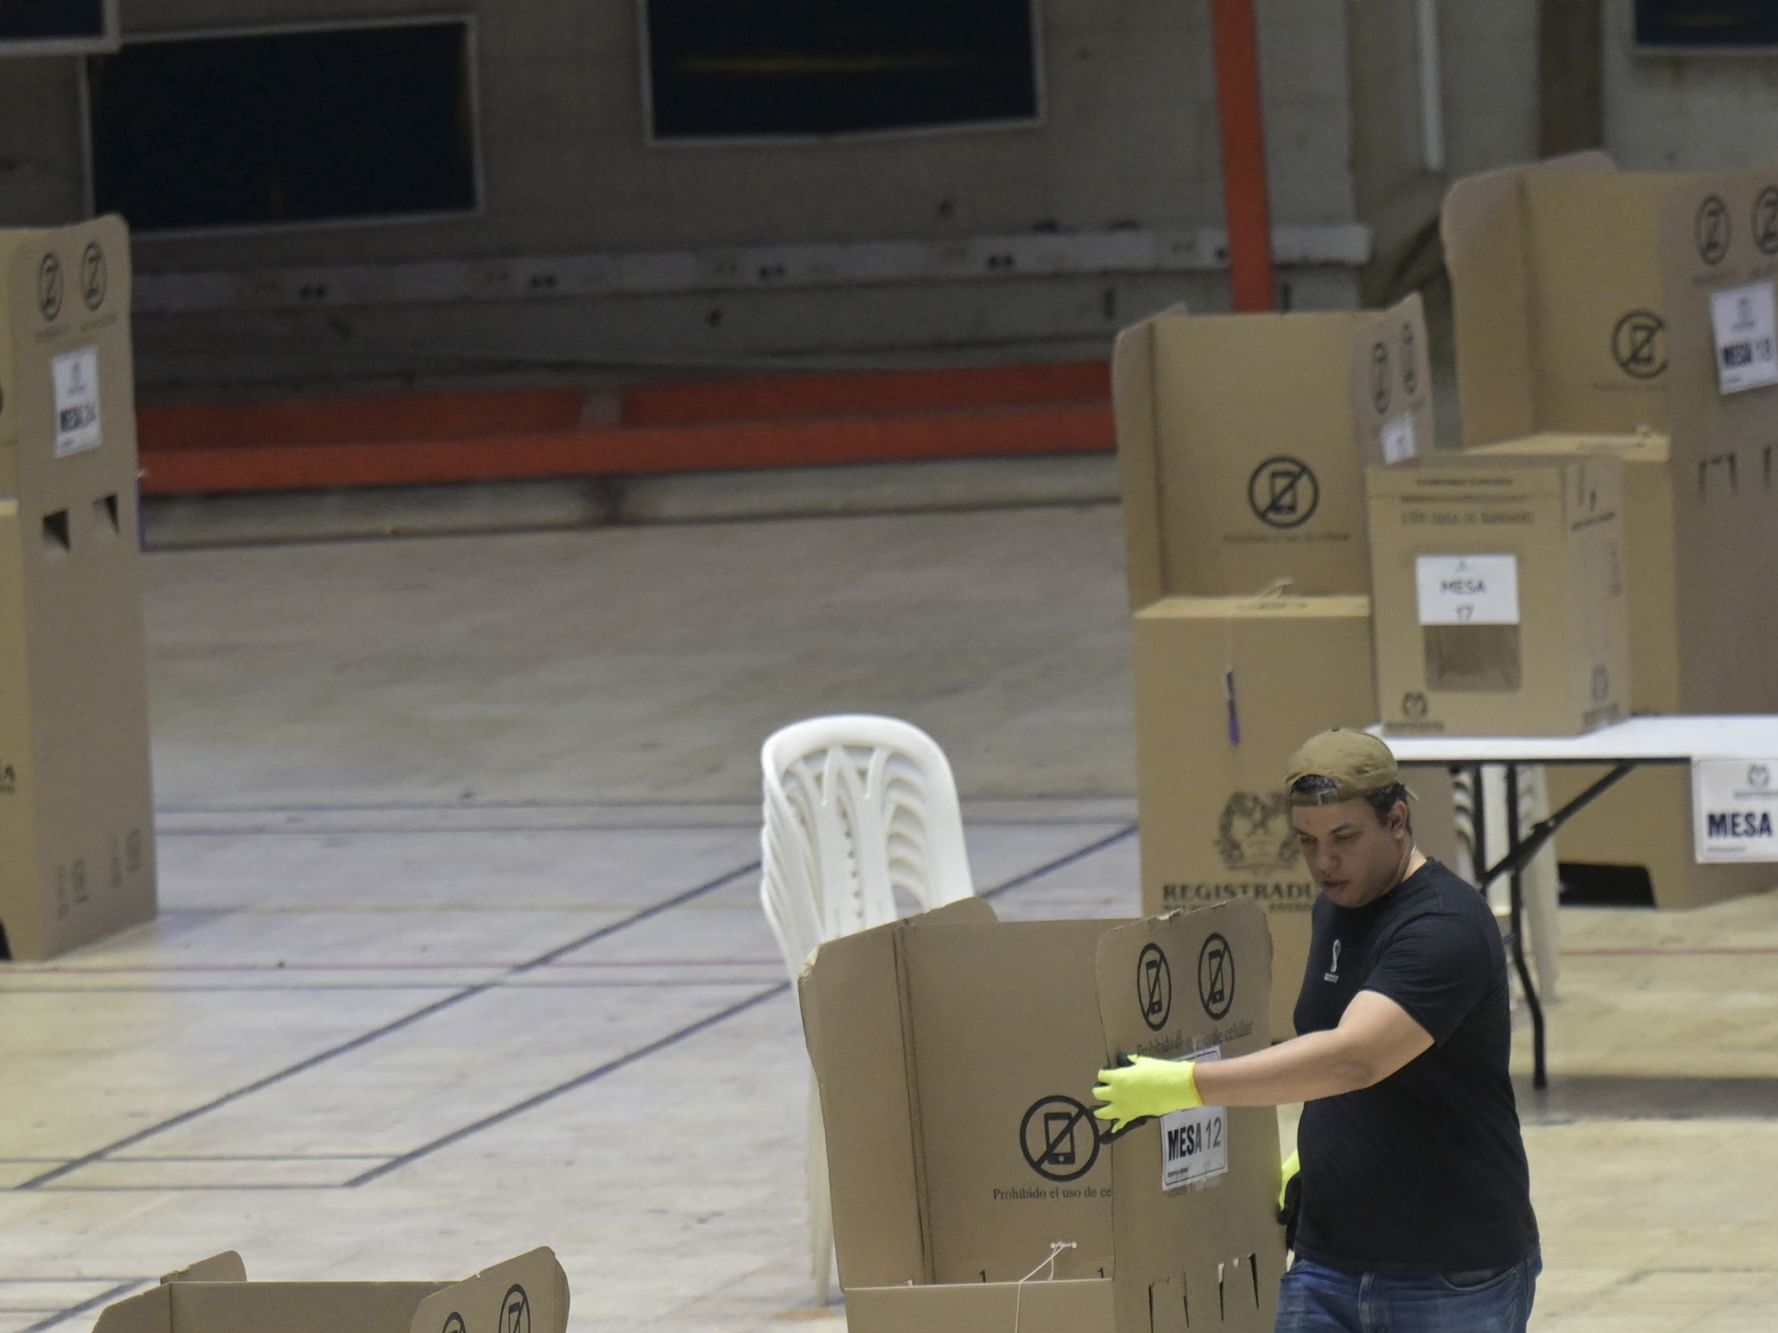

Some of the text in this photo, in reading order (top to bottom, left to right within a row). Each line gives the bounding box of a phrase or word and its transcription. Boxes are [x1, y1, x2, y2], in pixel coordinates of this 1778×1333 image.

[1440, 579, 1487, 594] MESA
[1707, 812, 1773, 838] MESA
[1167, 1117, 1222, 1162] MESA 12
[993, 1187, 1048, 1200] Prohibido
[1049, 1187, 1060, 1199] el
[1062, 1189, 1081, 1199] uso
[1083, 1187, 1098, 1198] de
